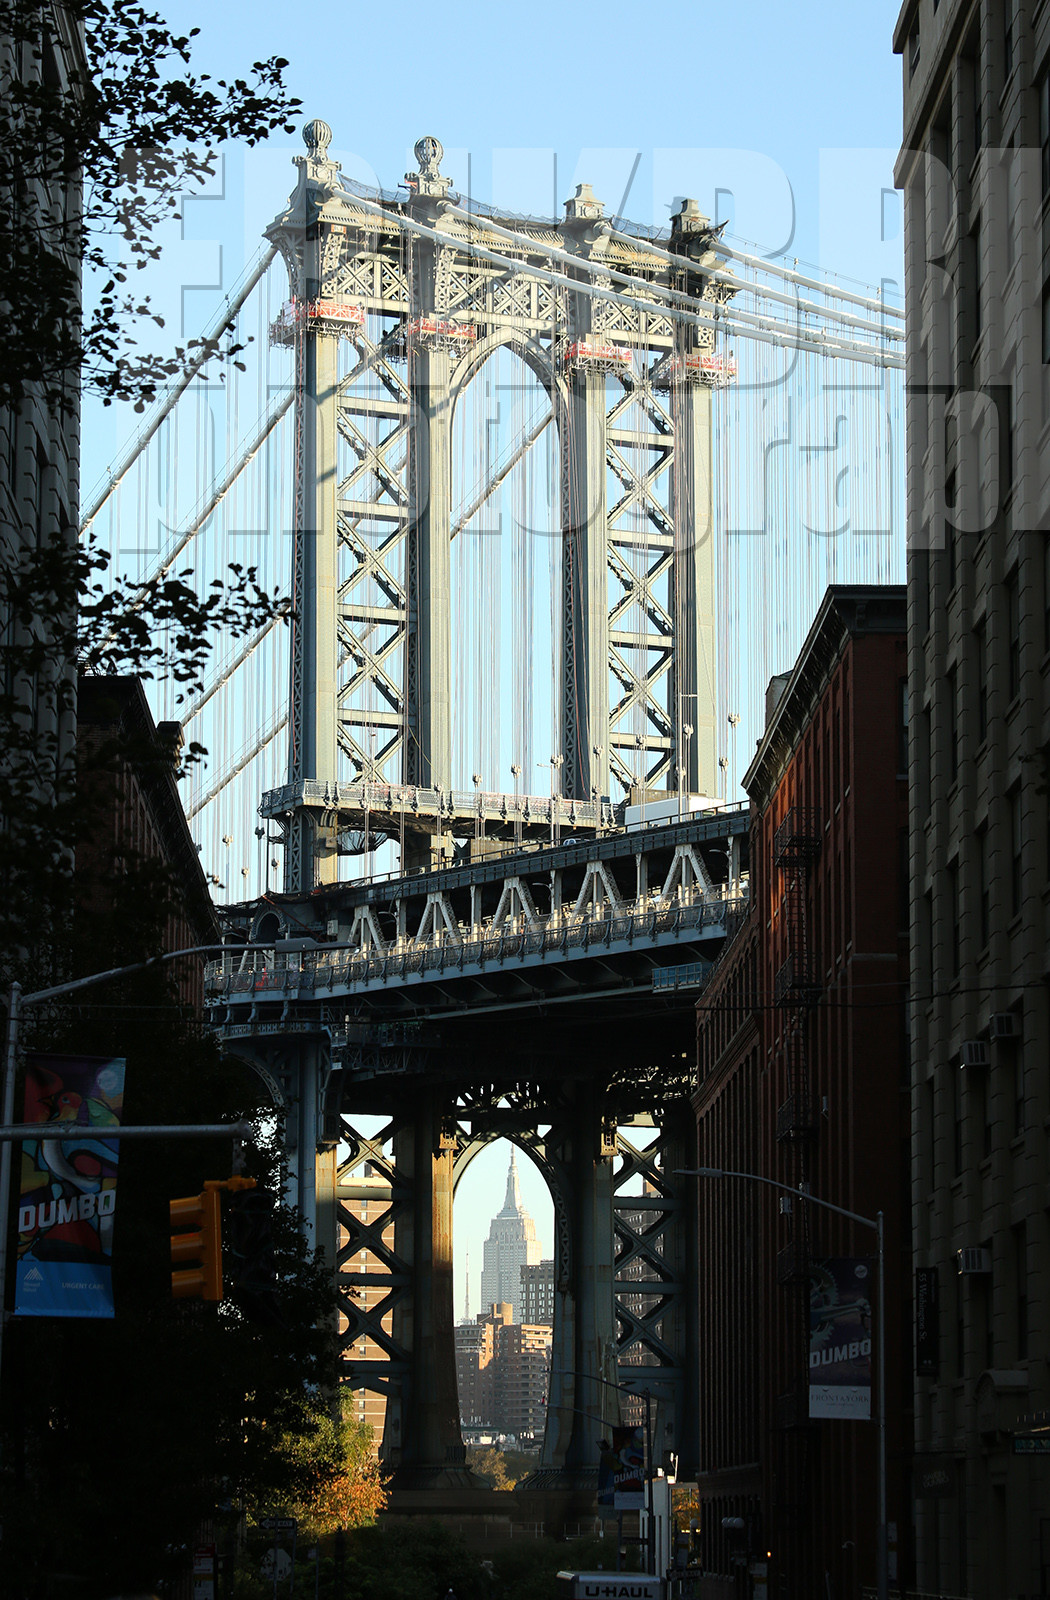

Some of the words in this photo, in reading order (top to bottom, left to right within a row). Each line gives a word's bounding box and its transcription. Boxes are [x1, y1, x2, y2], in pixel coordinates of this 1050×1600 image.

[18, 1189, 117, 1233] DUMBO
[810, 1338, 872, 1368] DUMBO
[613, 1468, 645, 1484] DUMBO
[585, 1586, 653, 1598] U-HAUL
